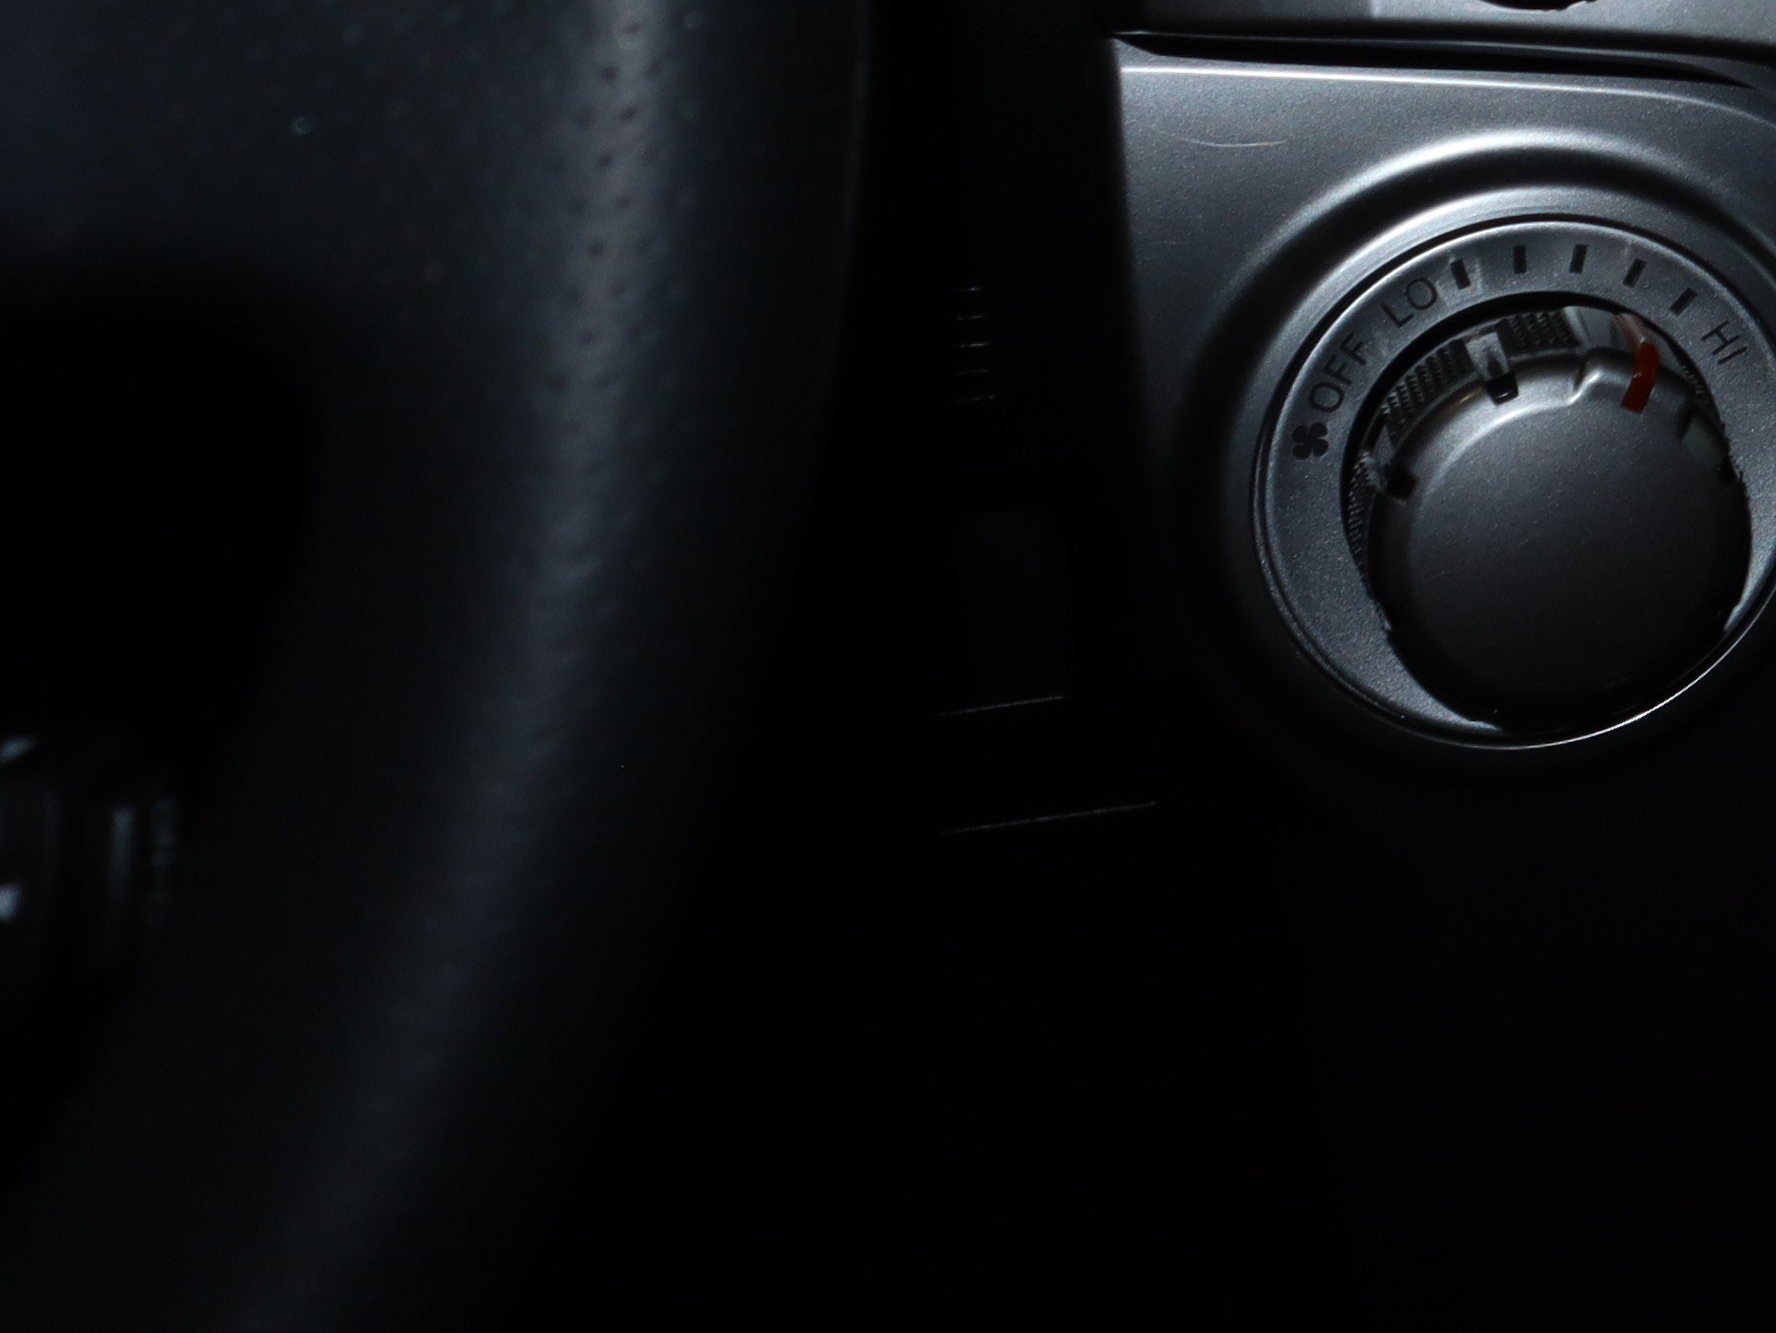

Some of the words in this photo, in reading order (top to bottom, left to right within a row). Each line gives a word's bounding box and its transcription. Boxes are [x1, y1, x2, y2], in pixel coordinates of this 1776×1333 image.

[1308, 333, 1370, 414] OFF
[1380, 276, 1438, 328] LO
[1701, 319, 1749, 366] HI
